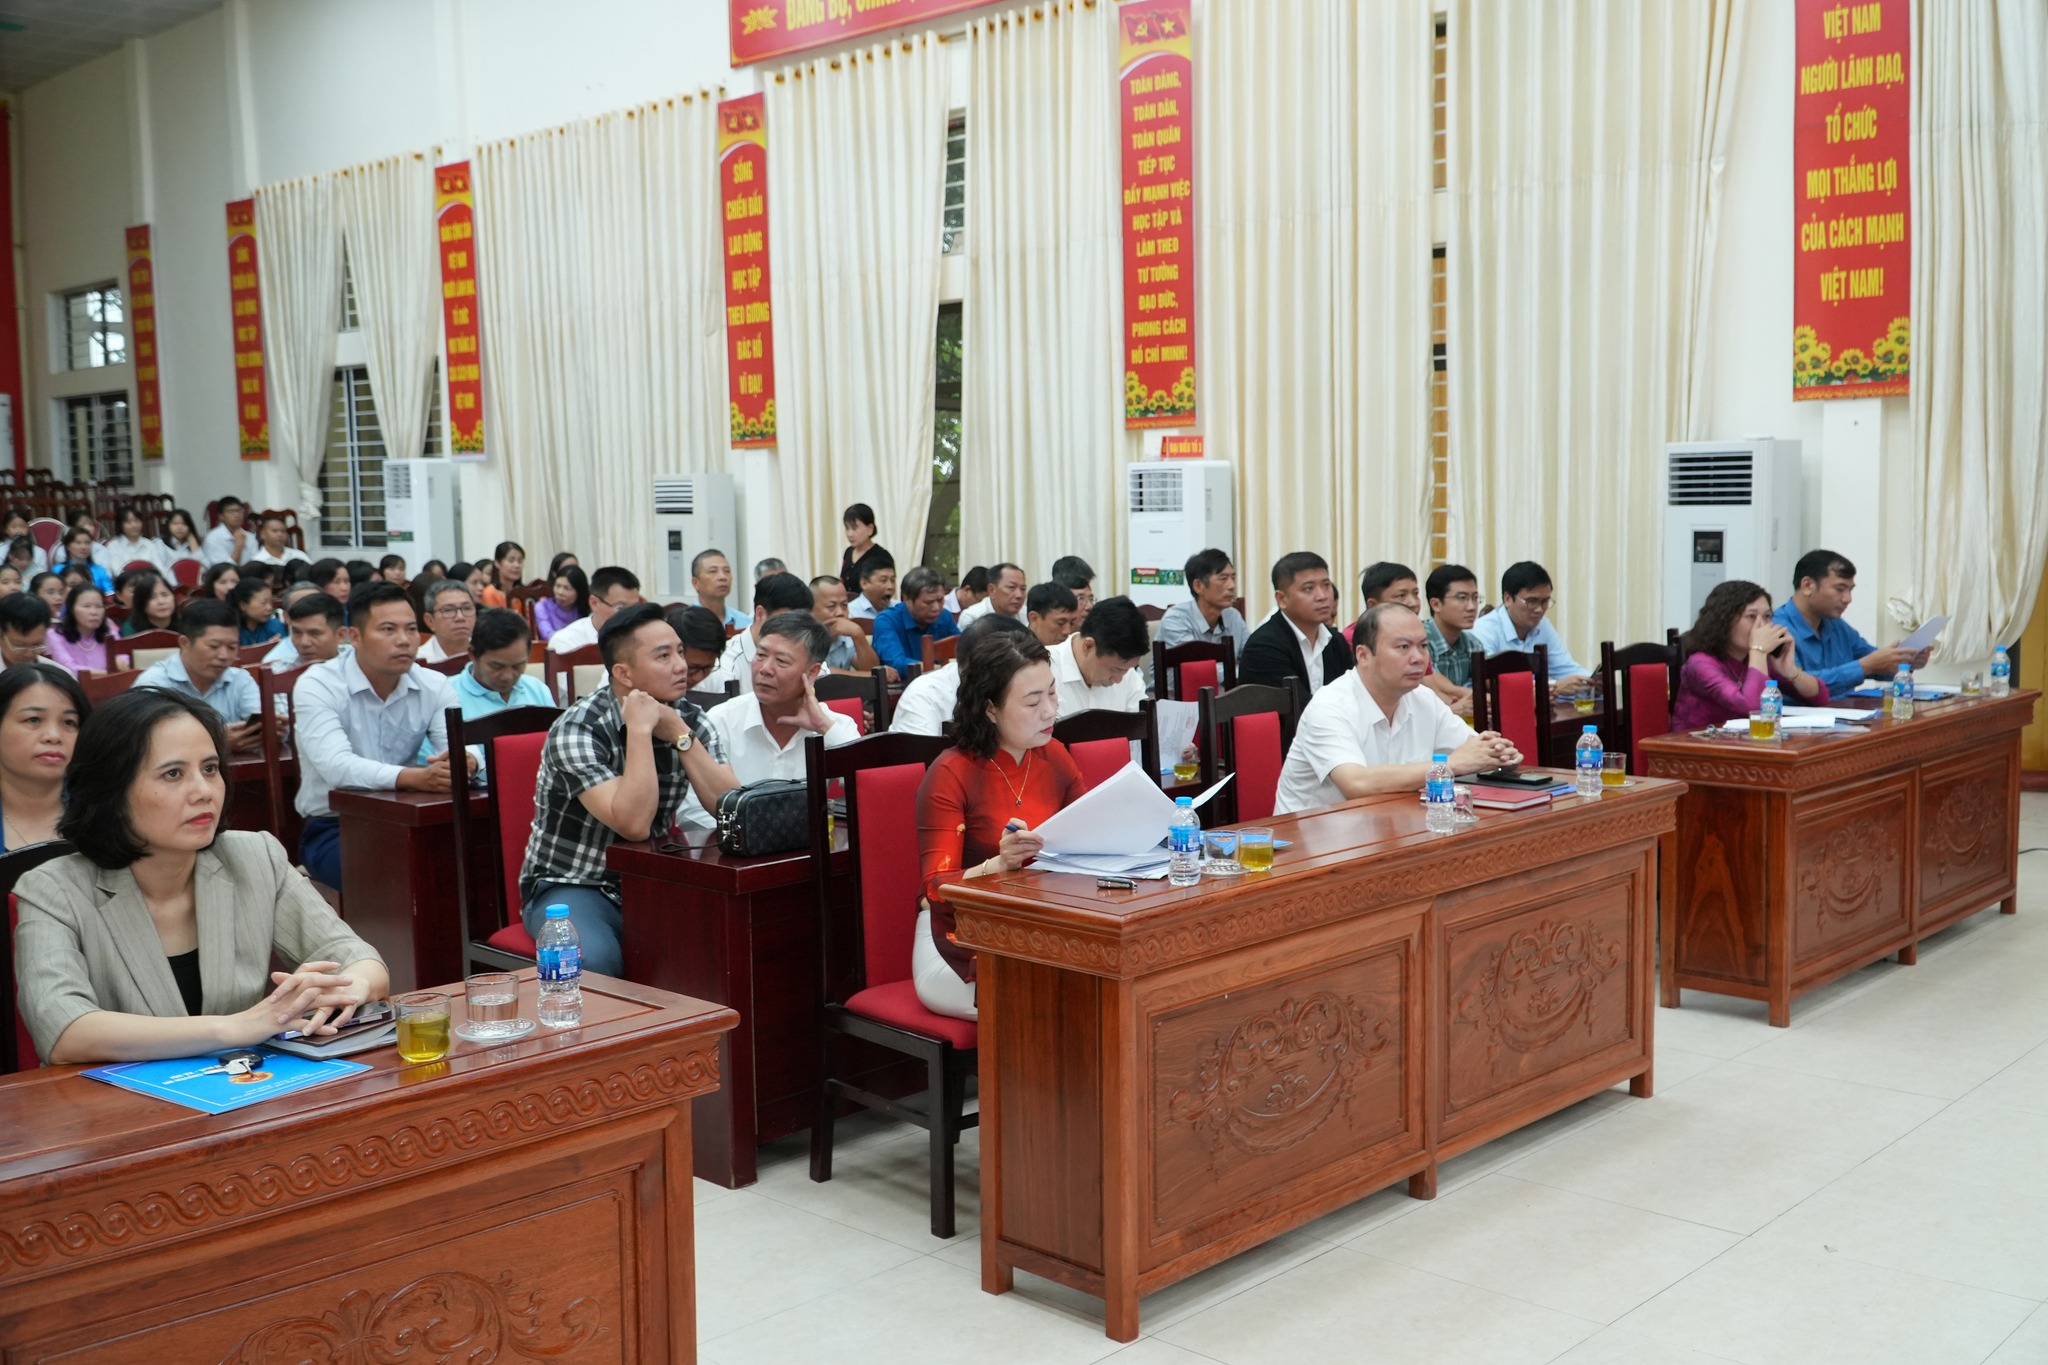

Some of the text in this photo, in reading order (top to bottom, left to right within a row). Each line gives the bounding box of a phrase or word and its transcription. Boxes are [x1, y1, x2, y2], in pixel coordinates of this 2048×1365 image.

[1823, 2, 1881, 44] VIỆT NAM
[1800, 52, 1904, 96] NGƯỜI LÃNH ĐẠO,
[1844, 103, 1878, 142] CHỨC
[1806, 153, 1897, 205] MỌI THẮNG LỢI
[1157, 236, 1180, 255] THEO
[1801, 212, 1827, 253] CỦA
[1829, 212, 1863, 249] CÁCH
[1820, 265, 1884, 307] VIỆT NAM!
[1132, 316, 1187, 338] PHONG CÁCH
